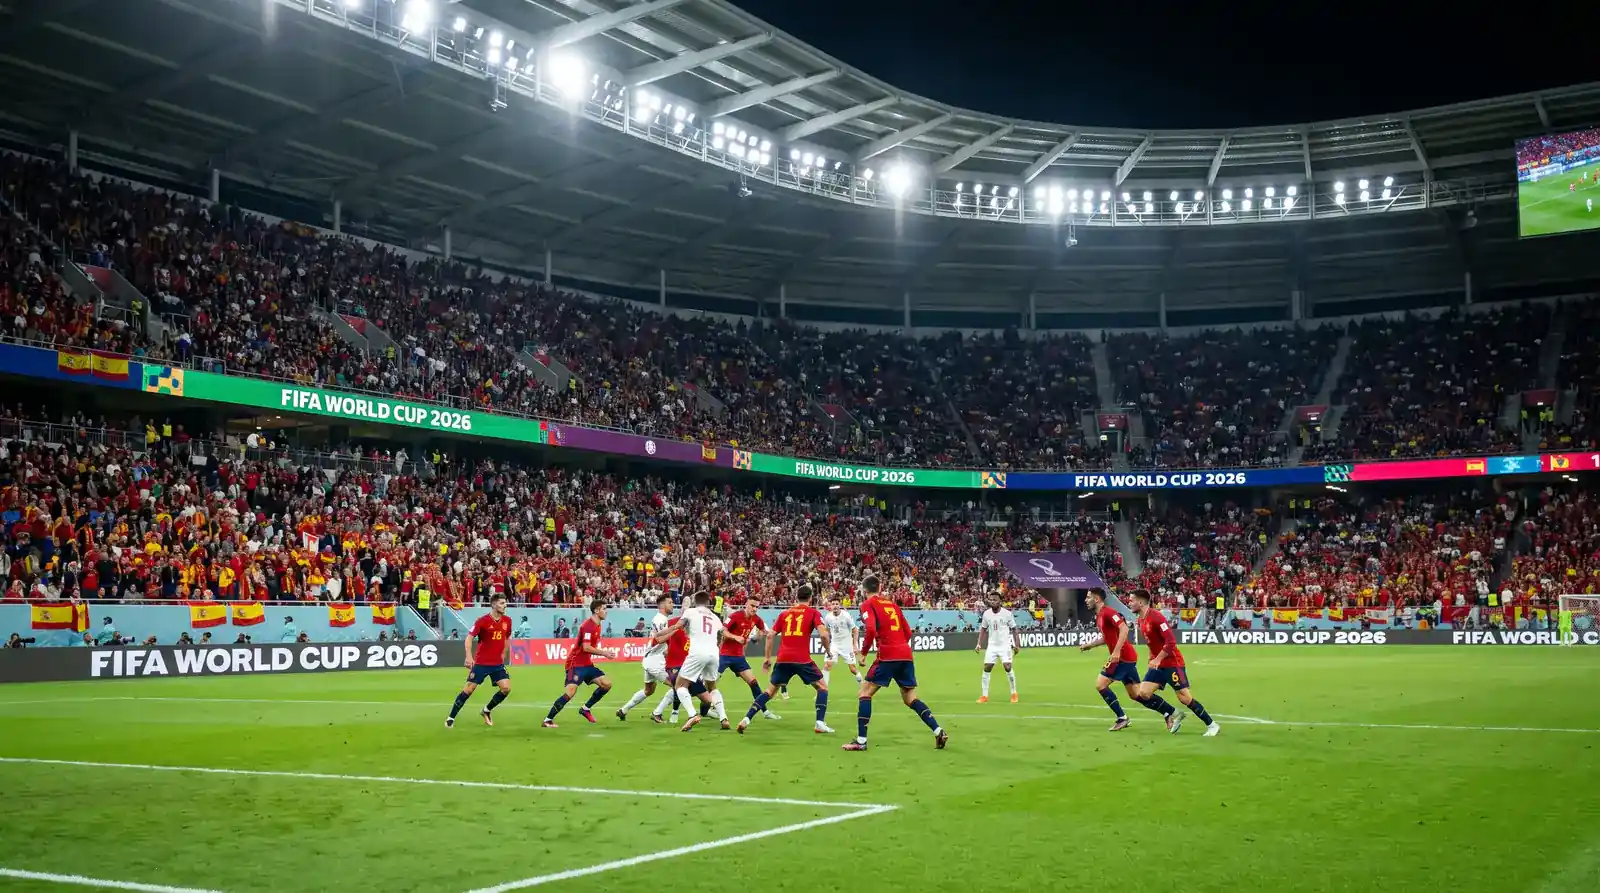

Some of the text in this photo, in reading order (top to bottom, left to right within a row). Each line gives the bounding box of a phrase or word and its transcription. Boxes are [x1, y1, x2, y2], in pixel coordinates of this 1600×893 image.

[281, 389, 472, 430] FIFA WORLD CUP 2026
[796, 462, 915, 483] FIFA WORLD CUP 2026
[1075, 472, 1246, 487] FIFA WORLD CUP 2026
[784, 614, 804, 637] 11
[884, 607, 900, 632] 3
[491, 631, 502, 640] 16
[914, 635, 945, 650] 2026
[1019, 632, 1056, 648] WORLD
[1058, 632, 1078, 646] CUP
[1181, 631, 1387, 644] FIFA WORLD CUP 2026
[1452, 631, 1497, 644] FIFA
[1499, 631, 1579, 644] WORLD
[545, 643, 568, 660] We
[91, 644, 439, 677] FIFA WORLD CUP 2026
[1171, 671, 1180, 682] 6
